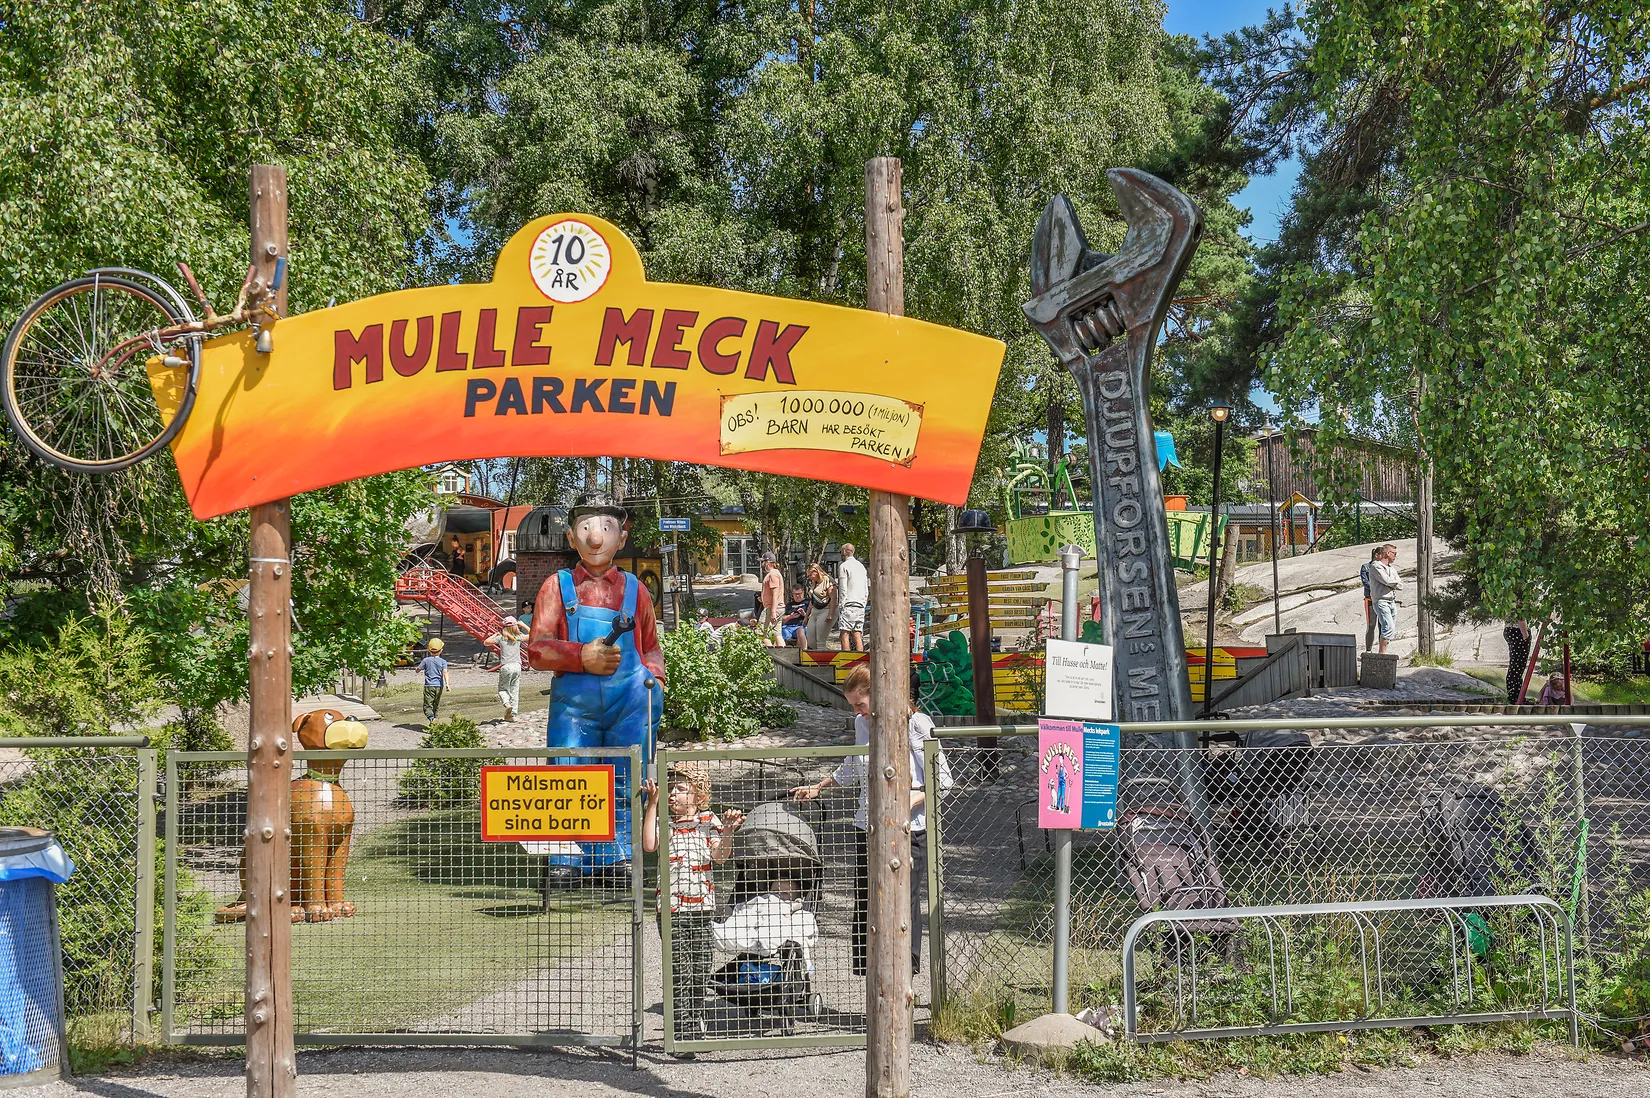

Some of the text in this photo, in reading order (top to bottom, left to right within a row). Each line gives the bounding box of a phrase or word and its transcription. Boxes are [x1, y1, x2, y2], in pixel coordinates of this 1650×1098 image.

[550, 234, 586, 267] 10
[551, 269, 580, 291] ÅR
[333, 305, 810, 391] MULLE MECK
[463, 377, 677, 418] PARKEN
[727, 402, 760, 433] OBS!
[766, 418, 886, 439] BARN HAR BESÖKT
[1052, 655, 1108, 671] Till Husse och Matte!
[1040, 723, 1066, 732] Välkommen
[1072, 725, 1083, 733] Mulle
[1083, 726, 1096, 734] Mecks
[1095, 727, 1110, 736] lekpark
[1041, 741, 1081, 775] MULLE MECK
[506, 774, 588, 791] Målsman
[489, 794, 606, 811] ansvarar för
[504, 813, 591, 830] sina barn
